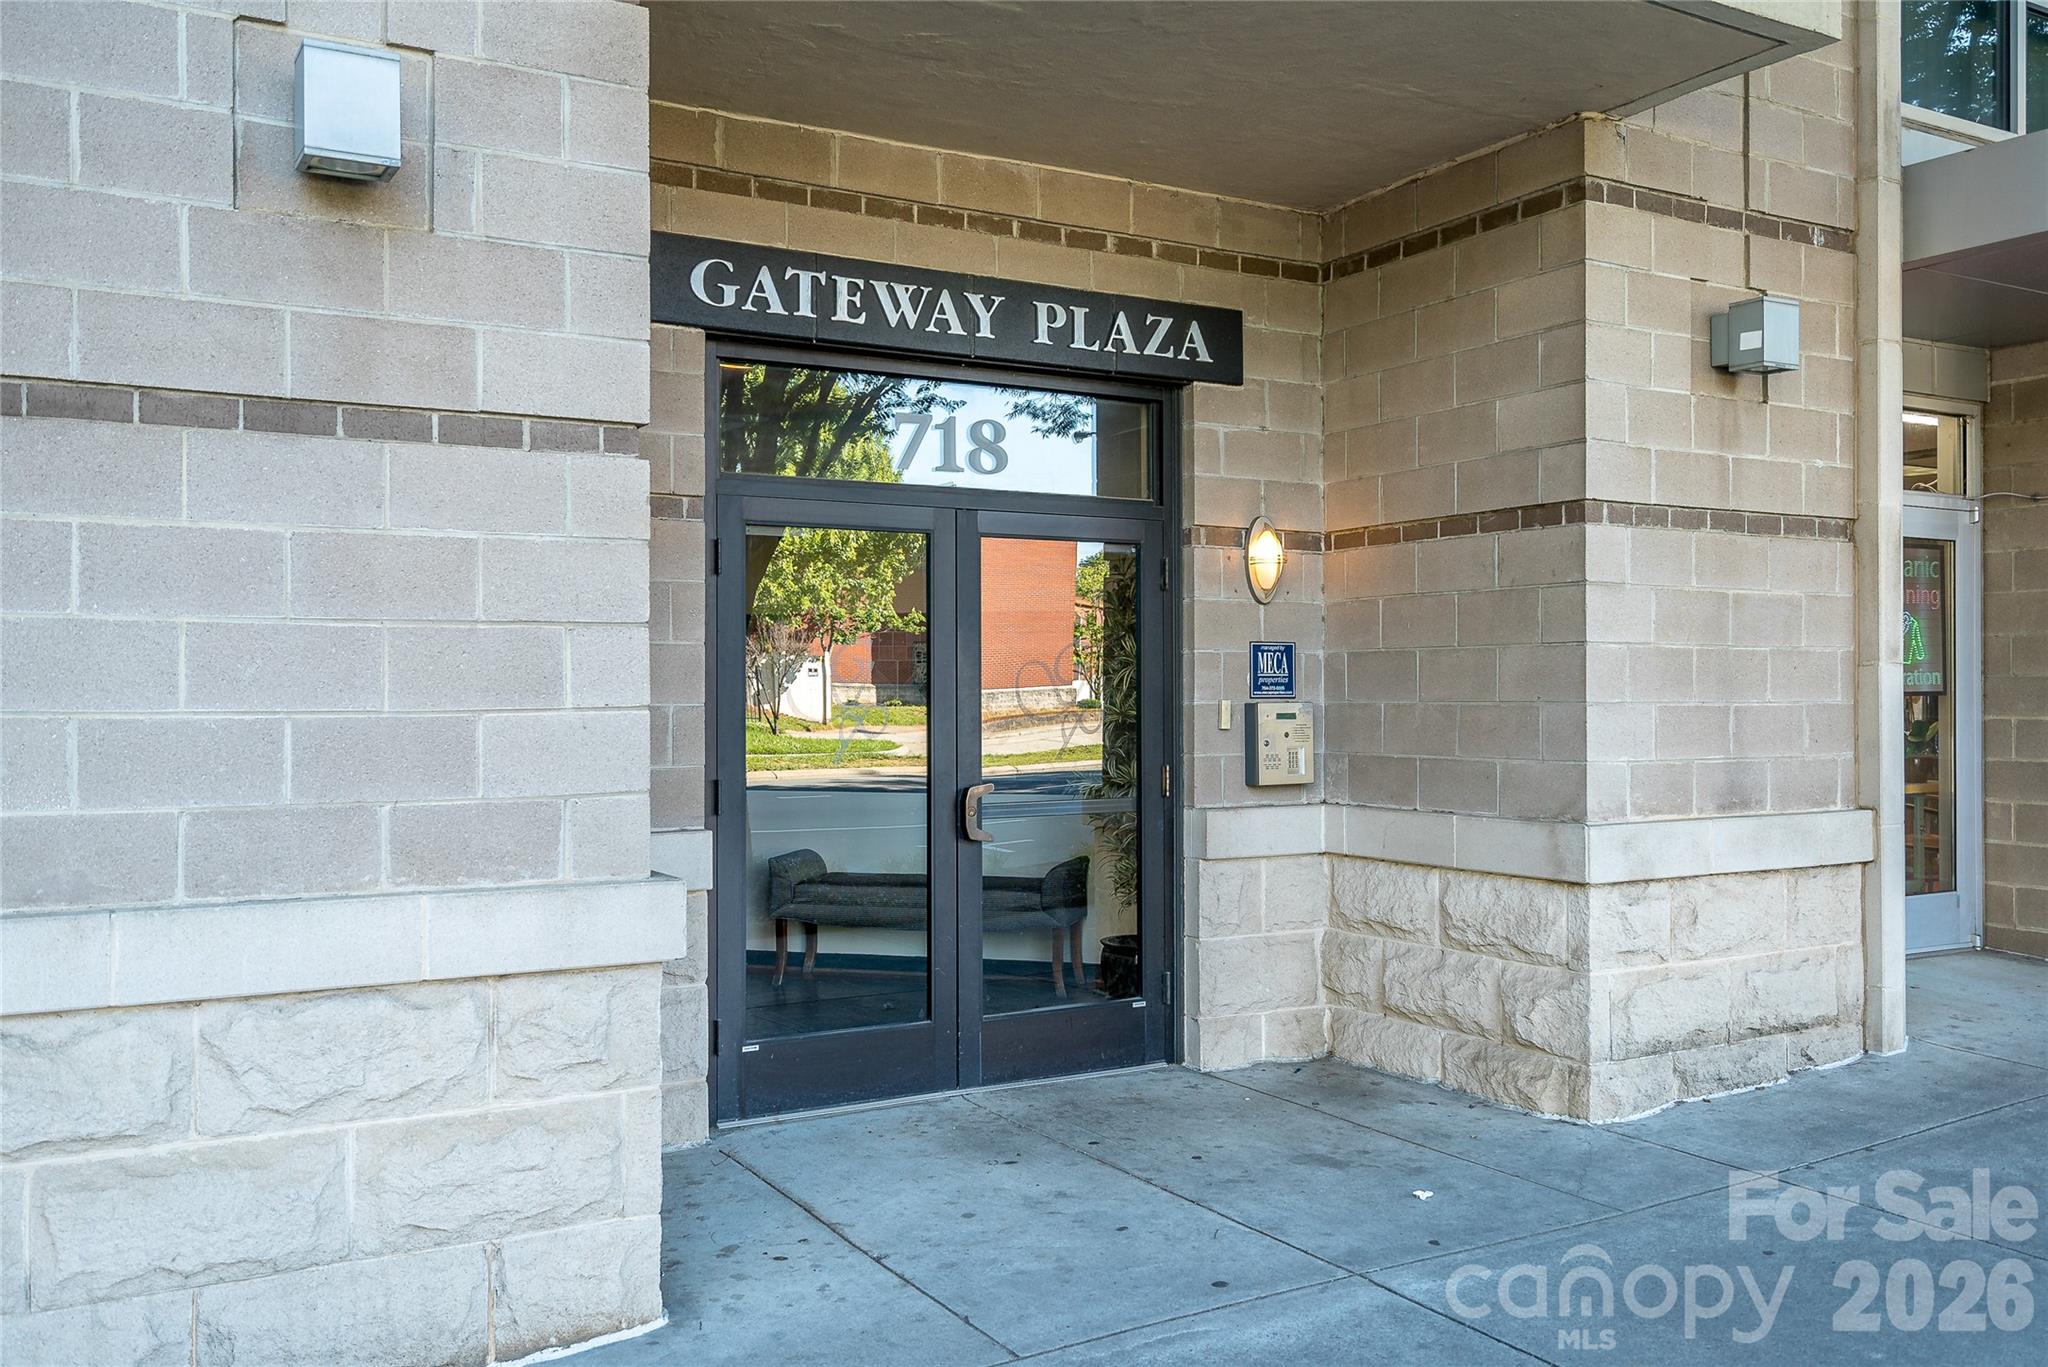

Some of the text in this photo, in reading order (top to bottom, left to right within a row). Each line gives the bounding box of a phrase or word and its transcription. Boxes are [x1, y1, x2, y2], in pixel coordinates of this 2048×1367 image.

[689, 258, 1214, 363] GATEWAY PLAZA
[894, 412, 1008, 475] 718
[1904, 556, 1940, 578] anic
[1905, 585, 1940, 610] ning
[1257, 651, 1289, 674] MECA
[1257, 676, 1289, 685] properties
